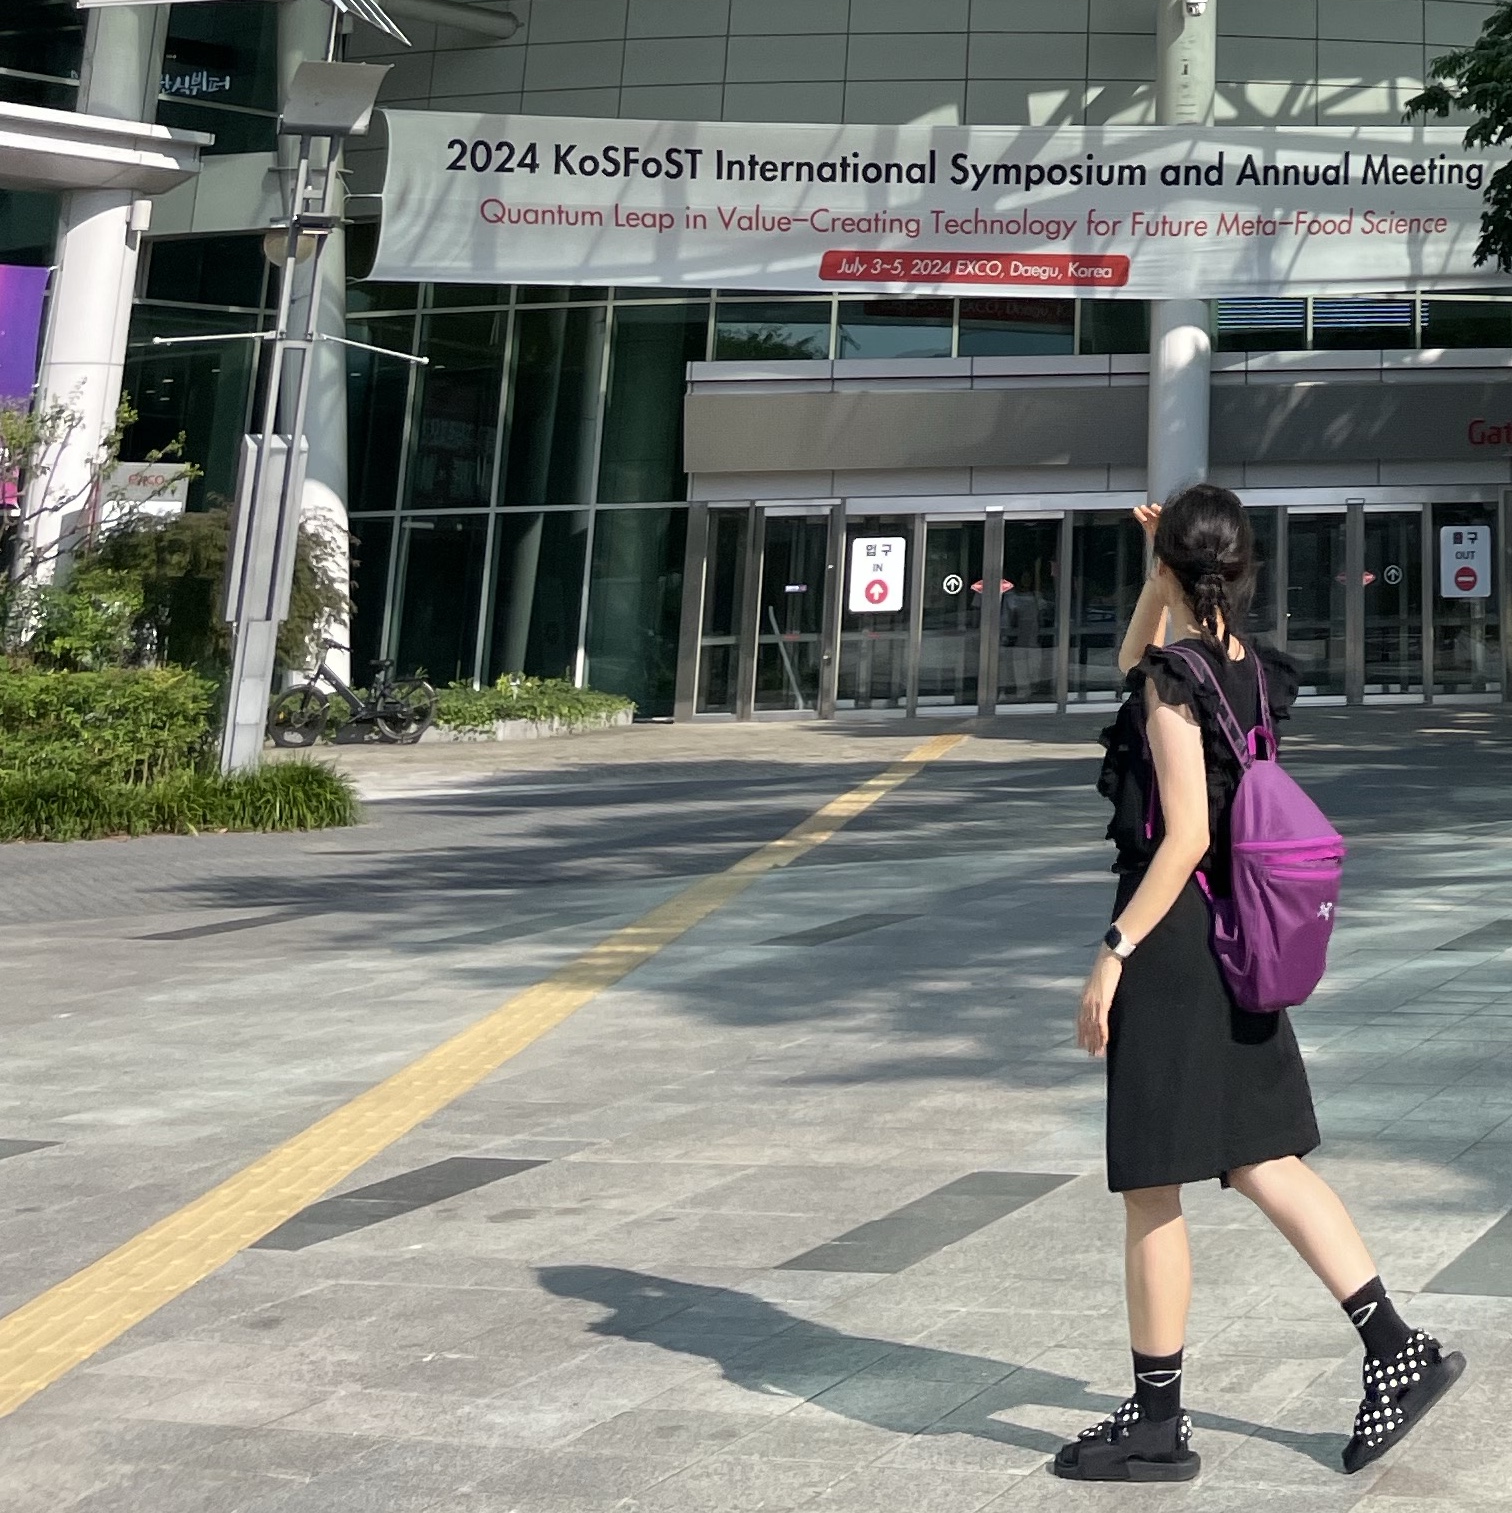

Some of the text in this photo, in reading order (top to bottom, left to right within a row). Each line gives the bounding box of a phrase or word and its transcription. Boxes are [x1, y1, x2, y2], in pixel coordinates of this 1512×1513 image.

[445, 138, 1484, 191] 2024 KoSFoST International Symposium and Annual Meeting
[480, 198, 604, 226] Quantum
[614, 204, 675, 233] Leap
[686, 207, 707, 230] in
[931, 208, 1077, 240] Technology
[1087, 208, 1121, 236] for
[1131, 211, 1208, 237] Future
[1361, 209, 1448, 235] Science
[837, 258, 867, 276] July
[911, 259, 951, 276] 2024
[955, 260, 1005, 279] EXCO,
[1010, 261, 1063, 281] Daegu,
[1067, 262, 1113, 279] Korea
[1455, 551, 1476, 560] OUT
[872, 563, 883, 572] IN
